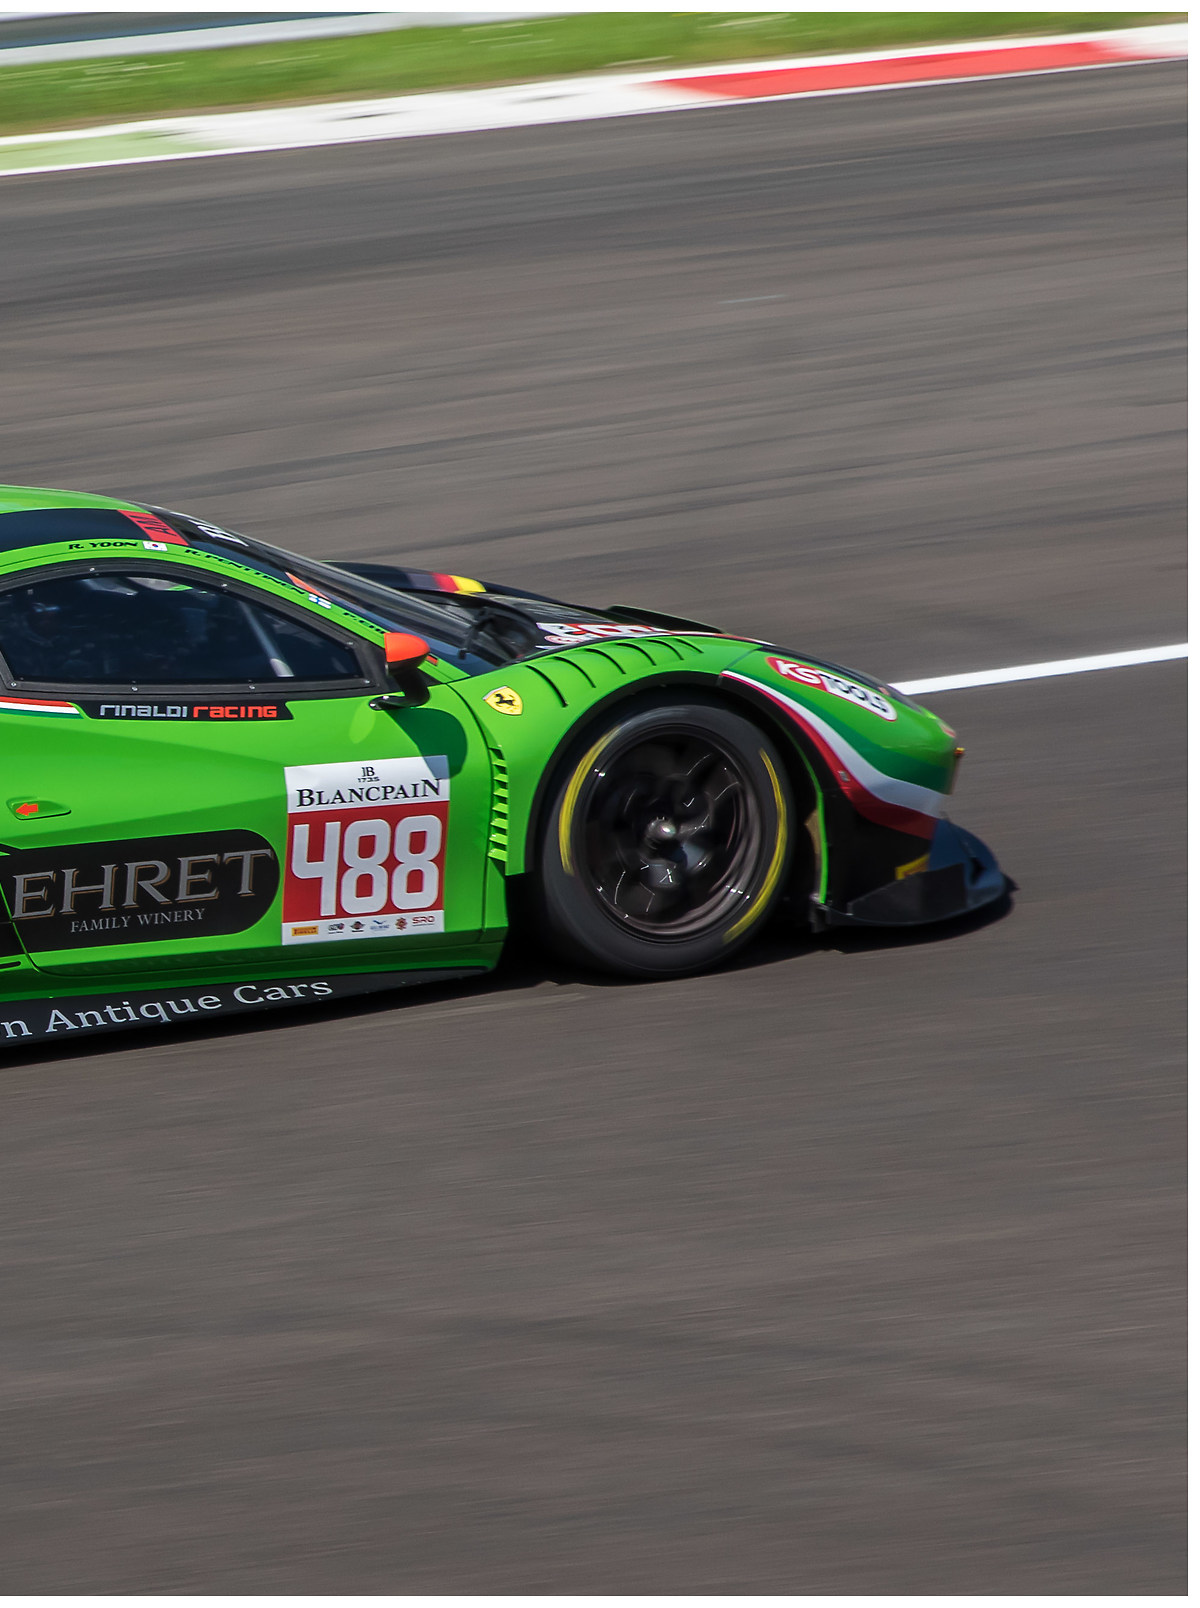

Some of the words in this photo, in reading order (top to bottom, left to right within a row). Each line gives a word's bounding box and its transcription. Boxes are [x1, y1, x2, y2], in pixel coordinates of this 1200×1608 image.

[775, 660, 822, 684] KS
[296, 777, 442, 808] BLANCPAIN
[11, 848, 275, 921] EHRET
[291, 814, 443, 917] 488
[70, 915, 131, 933] FAMILY
[137, 908, 206, 926] WINERY
[45, 994, 222, 1034] Antique
[232, 980, 334, 1005] Cars
